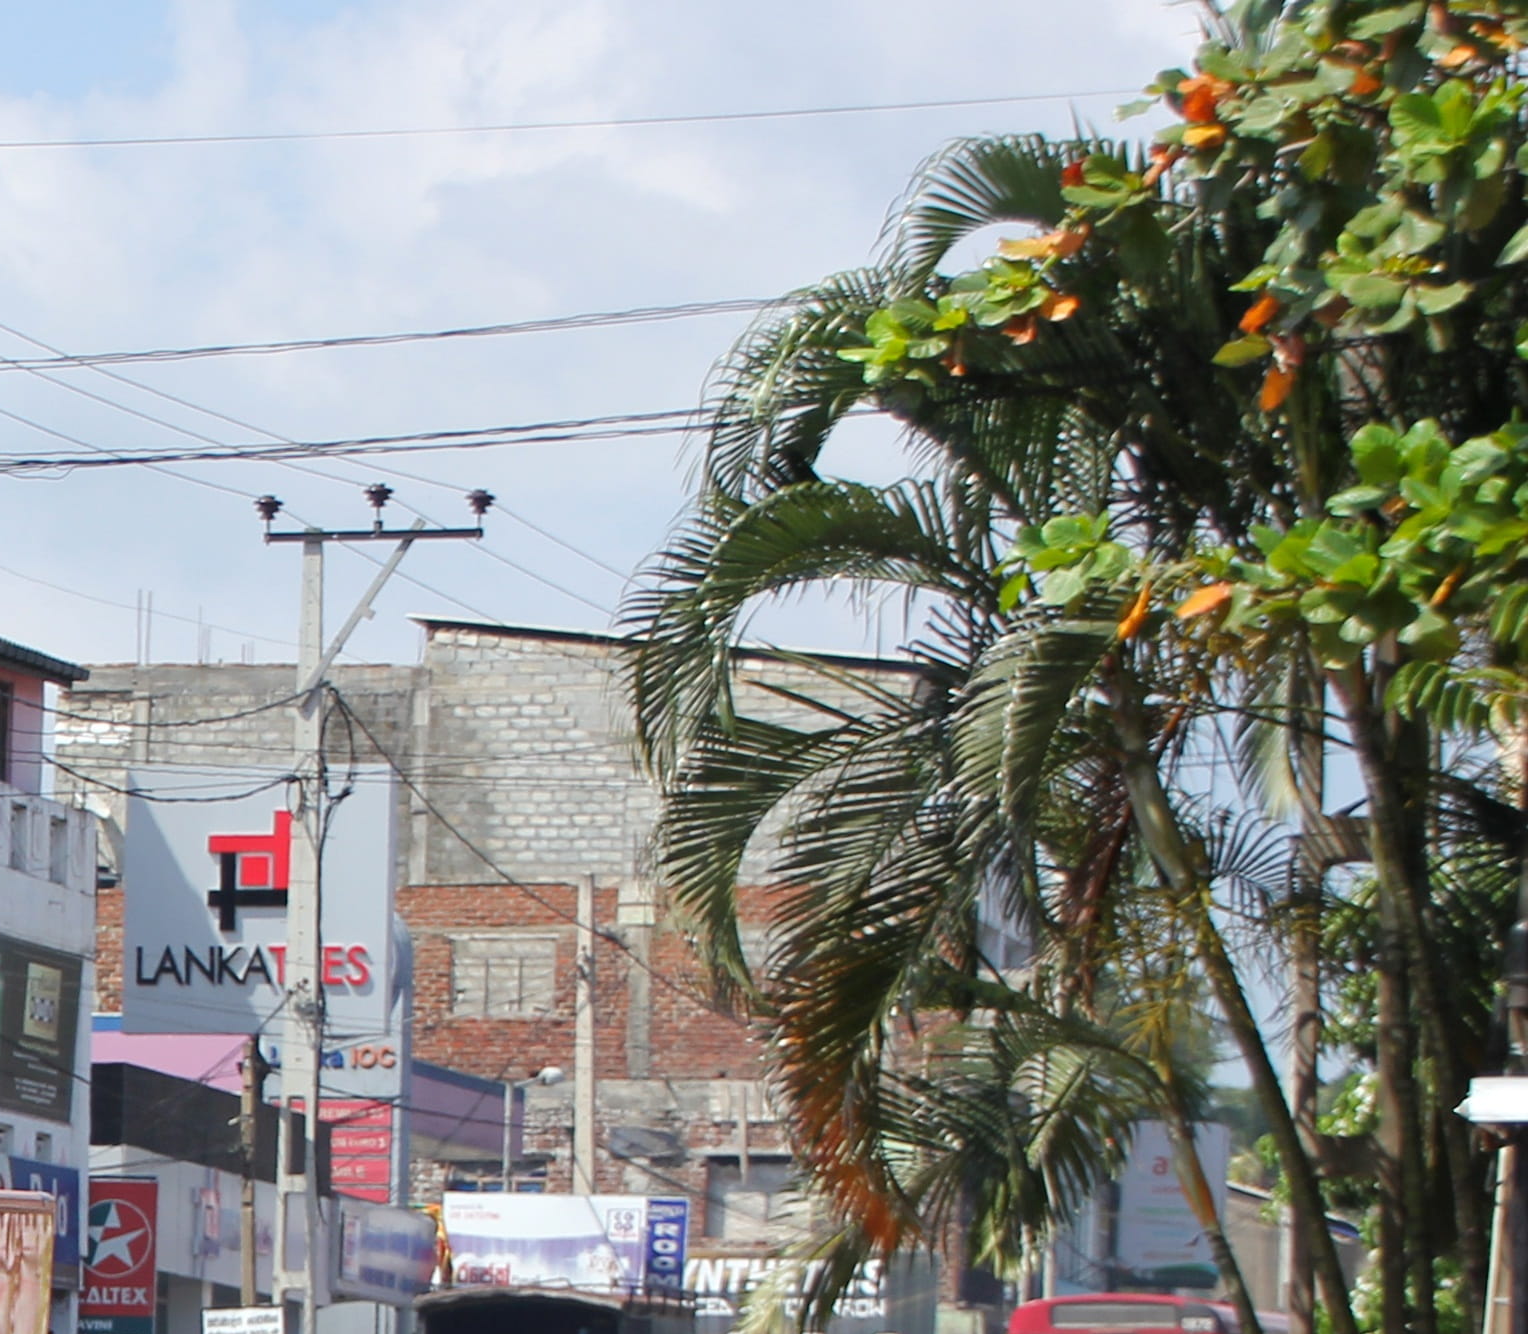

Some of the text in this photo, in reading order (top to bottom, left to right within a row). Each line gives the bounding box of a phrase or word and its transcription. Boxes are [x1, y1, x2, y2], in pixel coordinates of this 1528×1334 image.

[136, 945, 370, 986] LANKATES
[351, 1045, 397, 1069] IOC
[81, 1286, 148, 1305] ALTEX
